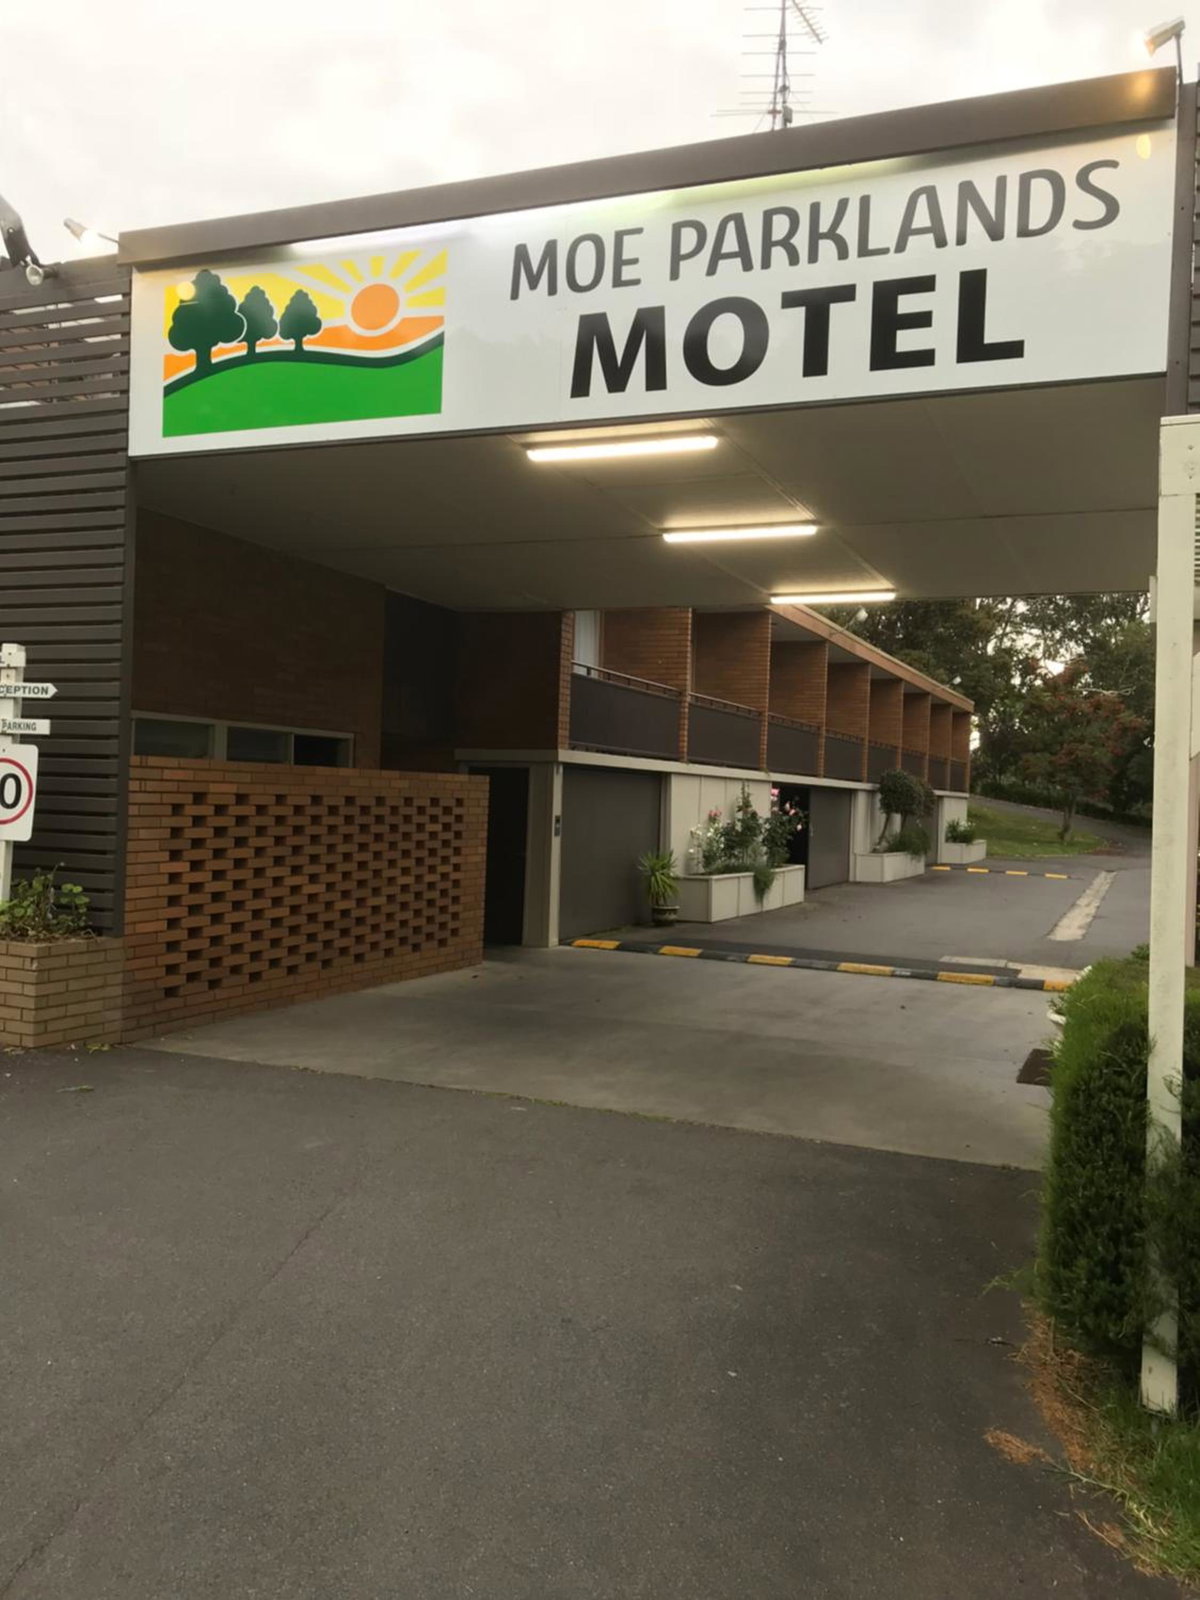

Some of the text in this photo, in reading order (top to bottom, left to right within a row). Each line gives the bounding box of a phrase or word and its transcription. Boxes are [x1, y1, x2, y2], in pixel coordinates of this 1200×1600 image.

[510, 160, 1120, 301] MOE PARKLANDS
[570, 268, 1025, 399] MOTEL
[2, 719, 37, 731] PARKING
